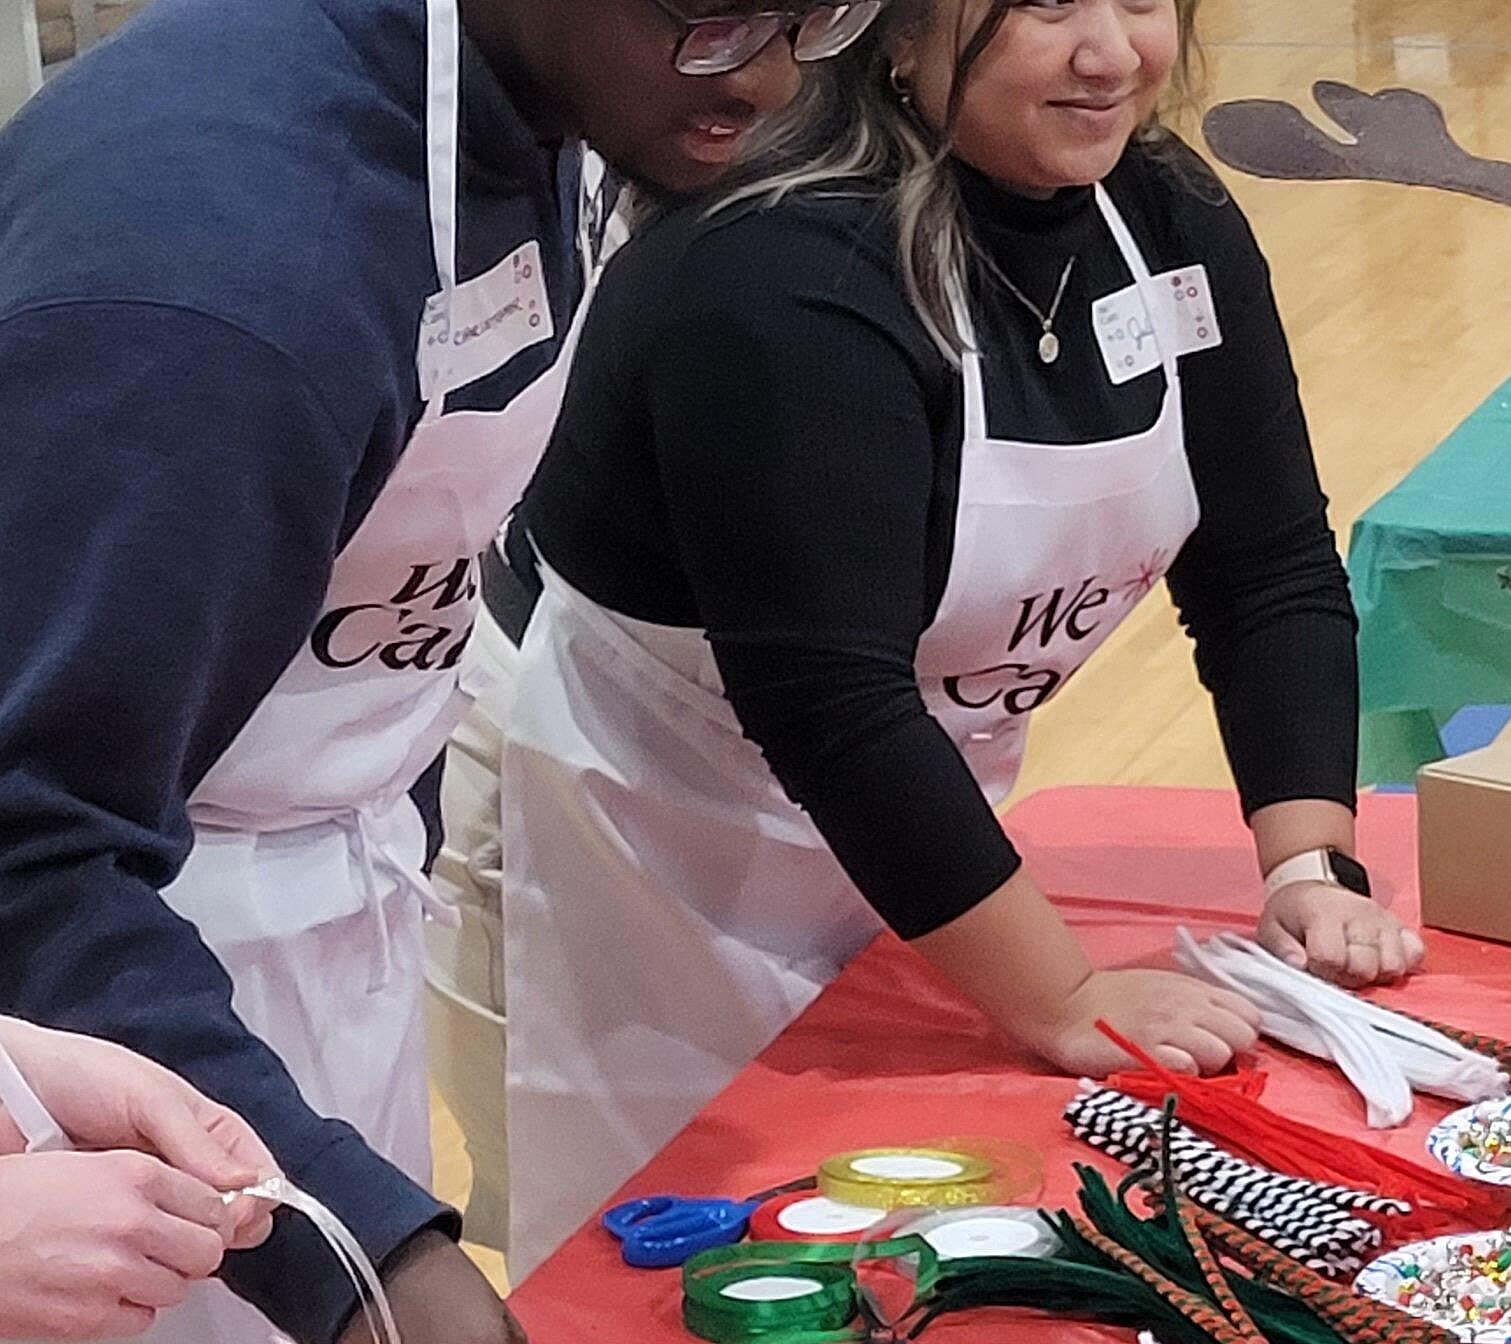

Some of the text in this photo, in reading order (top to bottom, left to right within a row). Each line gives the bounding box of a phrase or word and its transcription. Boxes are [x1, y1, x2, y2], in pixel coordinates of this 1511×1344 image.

[391, 558, 476, 609] W
[311, 604, 474, 670] Ca
[1007, 576, 1109, 652] We
[942, 663, 1060, 715] Ca
